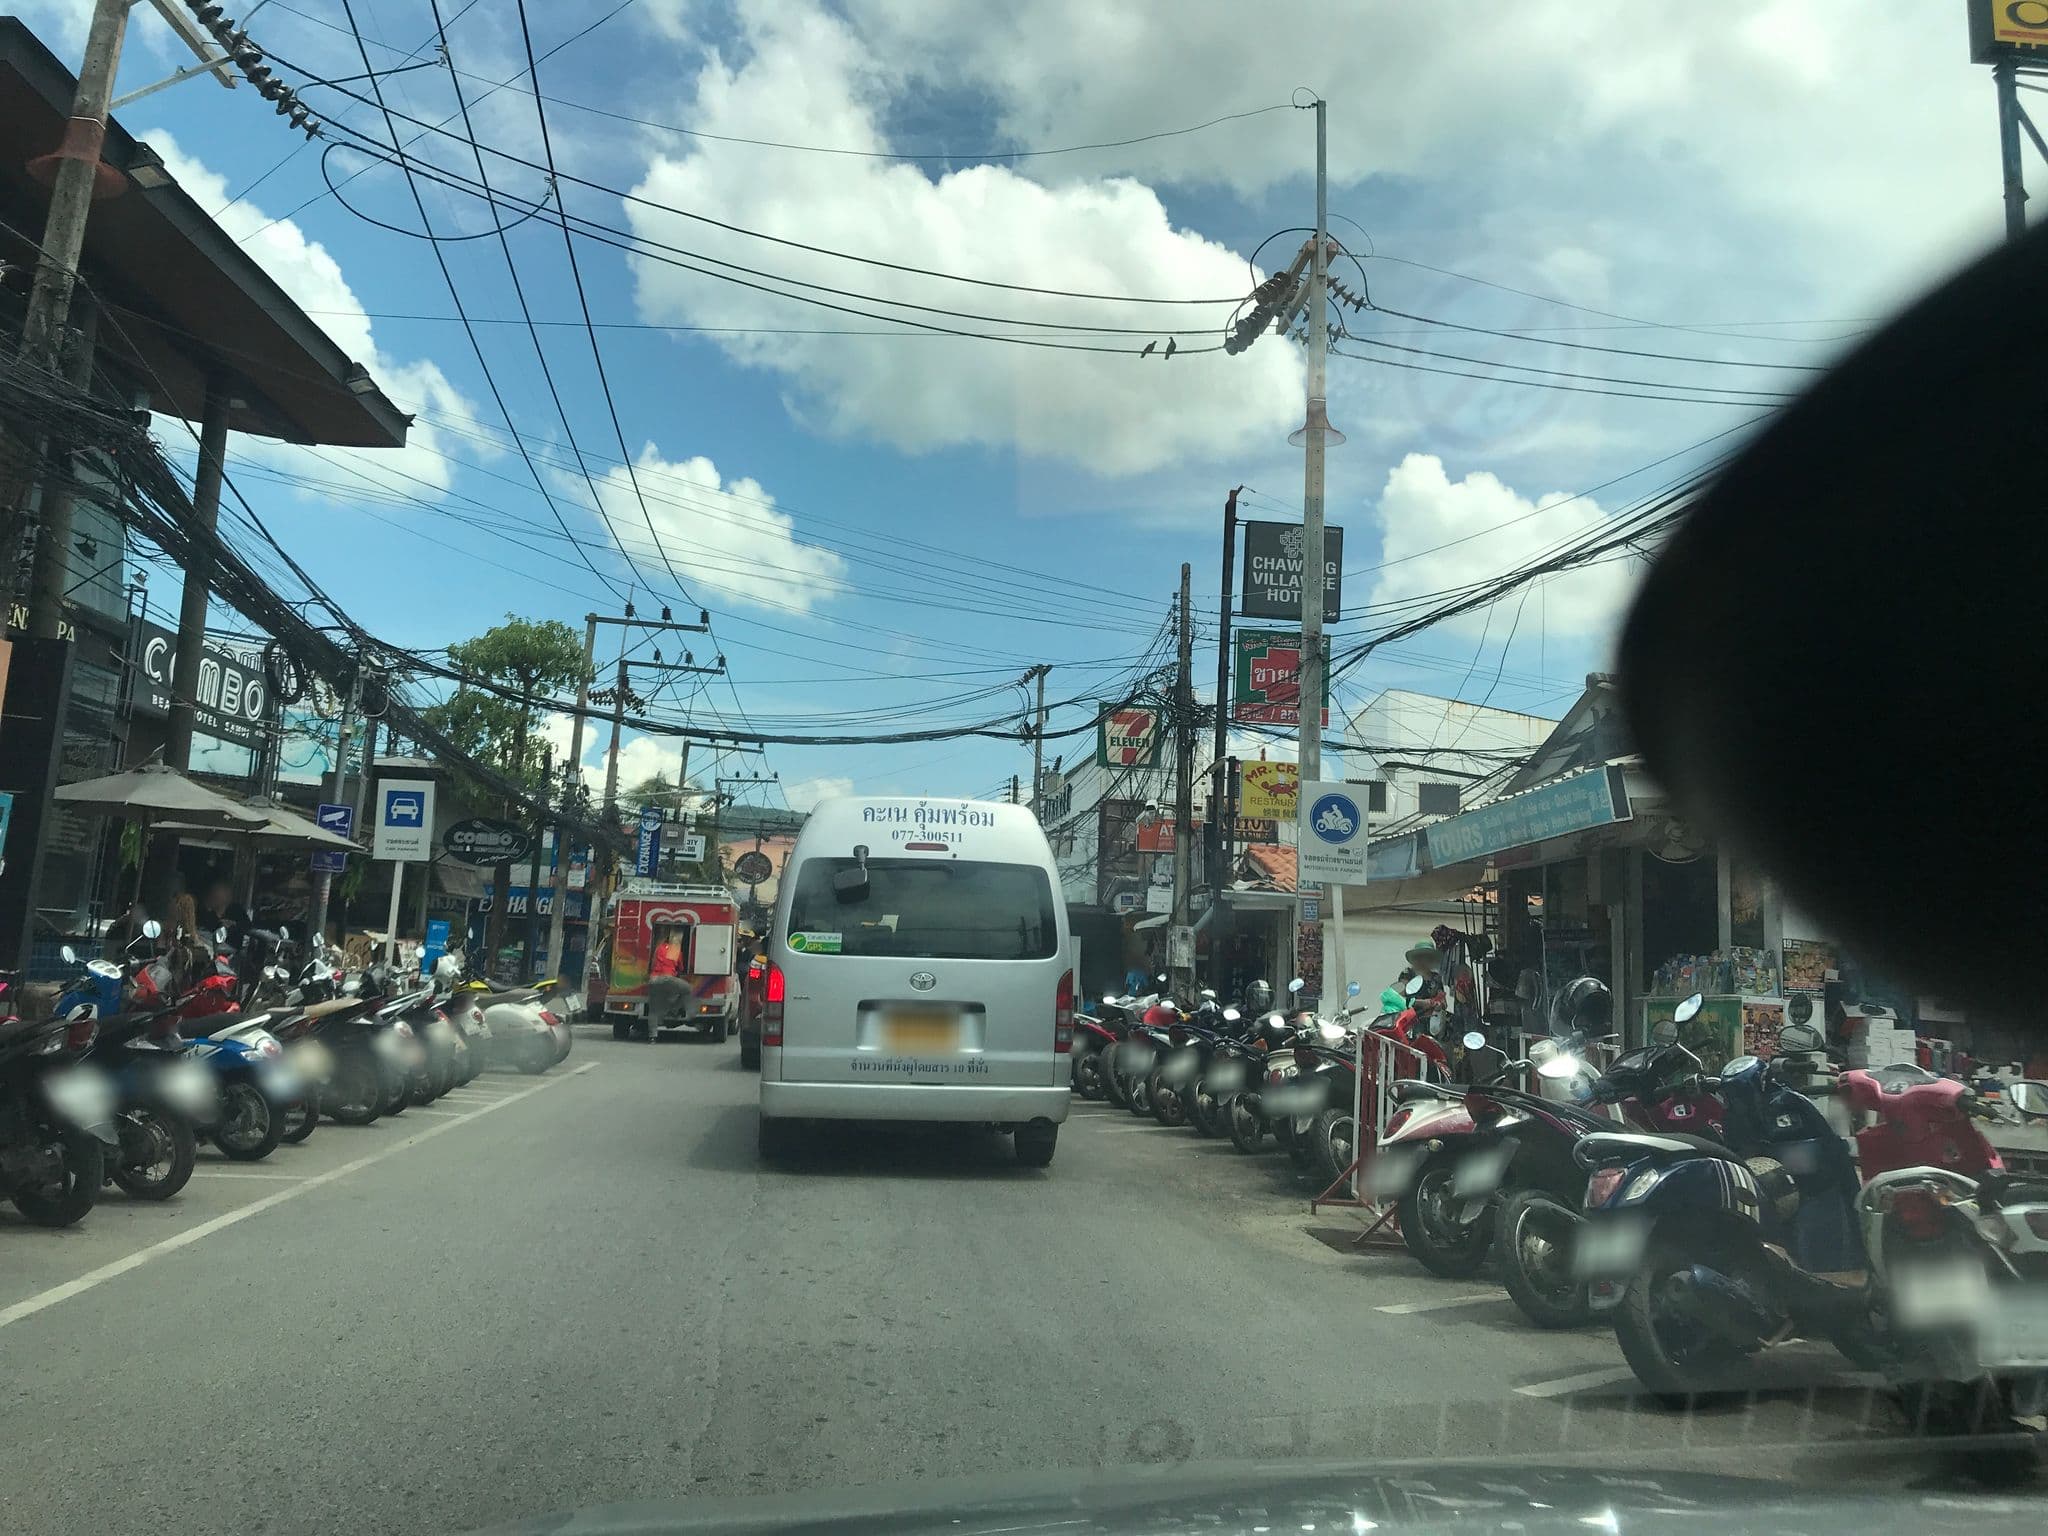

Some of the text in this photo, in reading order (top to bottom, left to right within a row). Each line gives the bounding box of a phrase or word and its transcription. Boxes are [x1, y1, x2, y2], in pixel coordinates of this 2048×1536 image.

[1252, 571, 1337, 590] VILLAE
[1266, 588, 1302, 603] HOT
[193, 710, 218, 729] OTEL
[1109, 735, 1150, 749] ELEVEN
[1249, 796, 1298, 808] RESTAUR
[914, 800, 995, 831] คุ้มพร้อม
[891, 829, 963, 843] 077-300511
[637, 830, 653, 875] EXCHANGE
[806, 942, 824, 952] GPS
